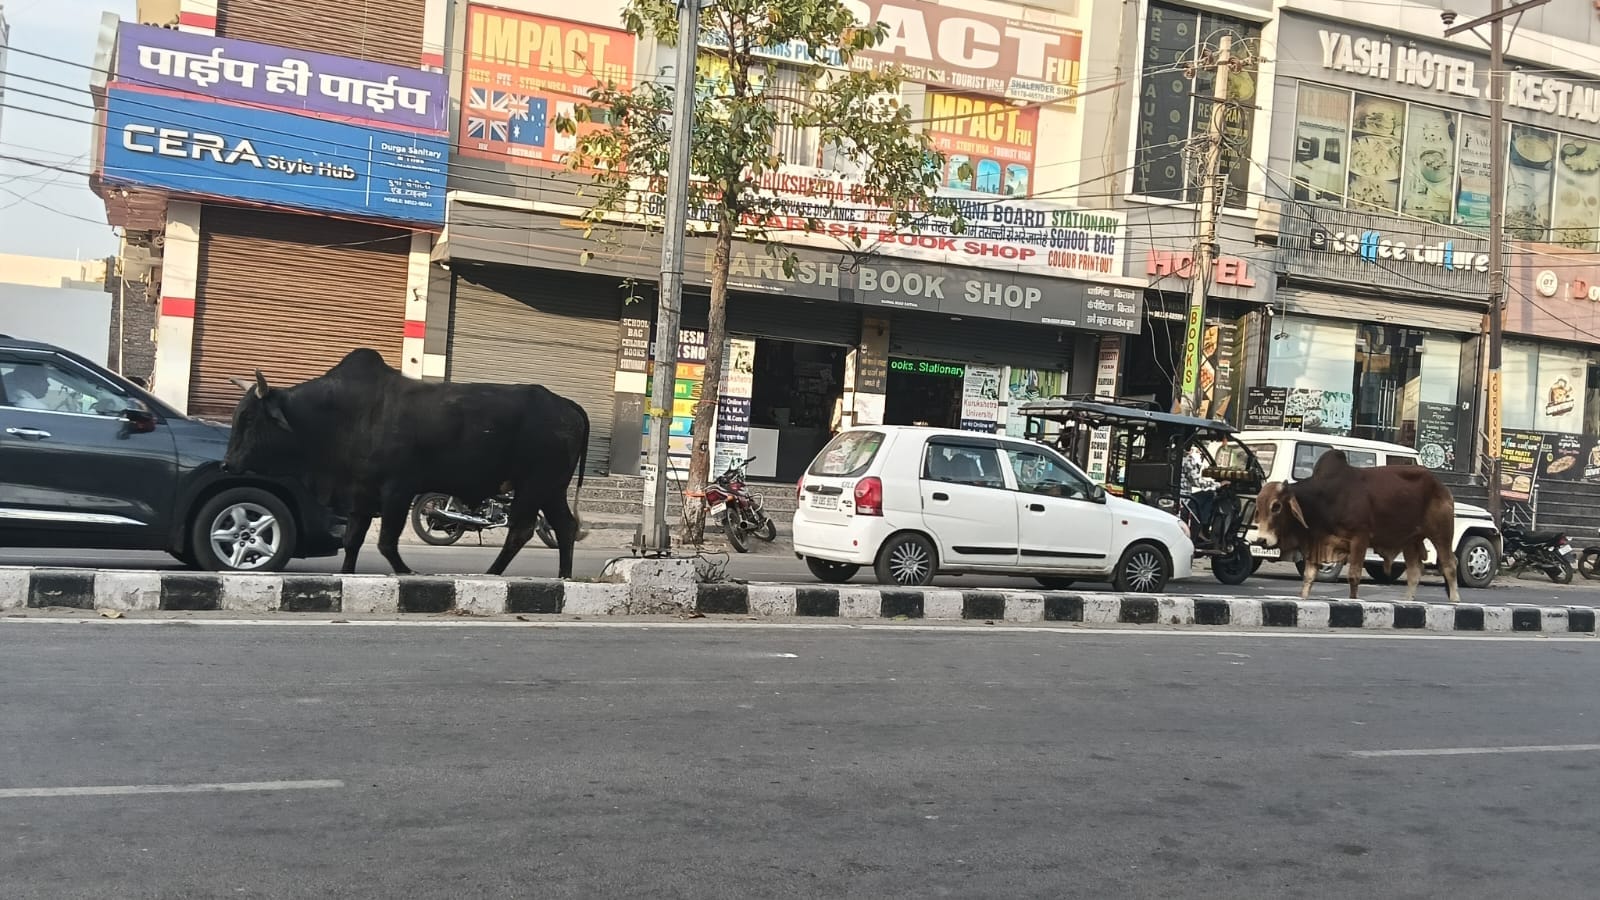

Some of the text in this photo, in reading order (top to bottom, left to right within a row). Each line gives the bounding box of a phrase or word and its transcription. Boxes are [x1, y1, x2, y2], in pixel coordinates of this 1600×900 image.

[470, 12, 611, 81] IMPACT
[1318, 29, 1392, 80] YASH
[1396, 45, 1481, 98] HOTEL
[137, 44, 431, 116] पाईप ही पाईप
[496, 72, 512, 87] PTE
[951, 72, 986, 89] TOURIST
[986, 78, 1005, 93] VISA
[1011, 79, 1055, 93] SHALENDER
[931, 92, 1032, 147] MPACT FUL
[122, 123, 263, 169] CERA
[266, 154, 314, 177] Style
[317, 160, 358, 181] Hub
[381, 142, 442, 159] Durga Sanitary
[744, 169, 844, 202] KRUKSHETRA
[992, 204, 1046, 229] BOARD
[1051, 208, 1119, 235] STATIONARY
[878, 228, 958, 252] BOOK
[963, 240, 1037, 261] SHOP
[1049, 228, 1115, 256] SCHOOL BAG
[1332, 229, 1490, 273] coffee culture
[1047, 250, 1077, 270] COLOUR
[1147, 250, 1257, 288] HOEL
[704, 248, 1043, 310] ARESH BOOK SHOP
[623, 318, 649, 328] SCHOOL
[627, 328, 643, 338] BAG
[621, 338, 648, 349] CHILDREN
[678, 330, 705, 345] RESH
[1185, 311, 1198, 384] BOOKS
[623, 348, 645, 357] BOOKS
[919, 362, 964, 378] Stationary
[1091, 441, 1108, 450] SCHOOL
[1093, 451, 1103, 460] BAG
